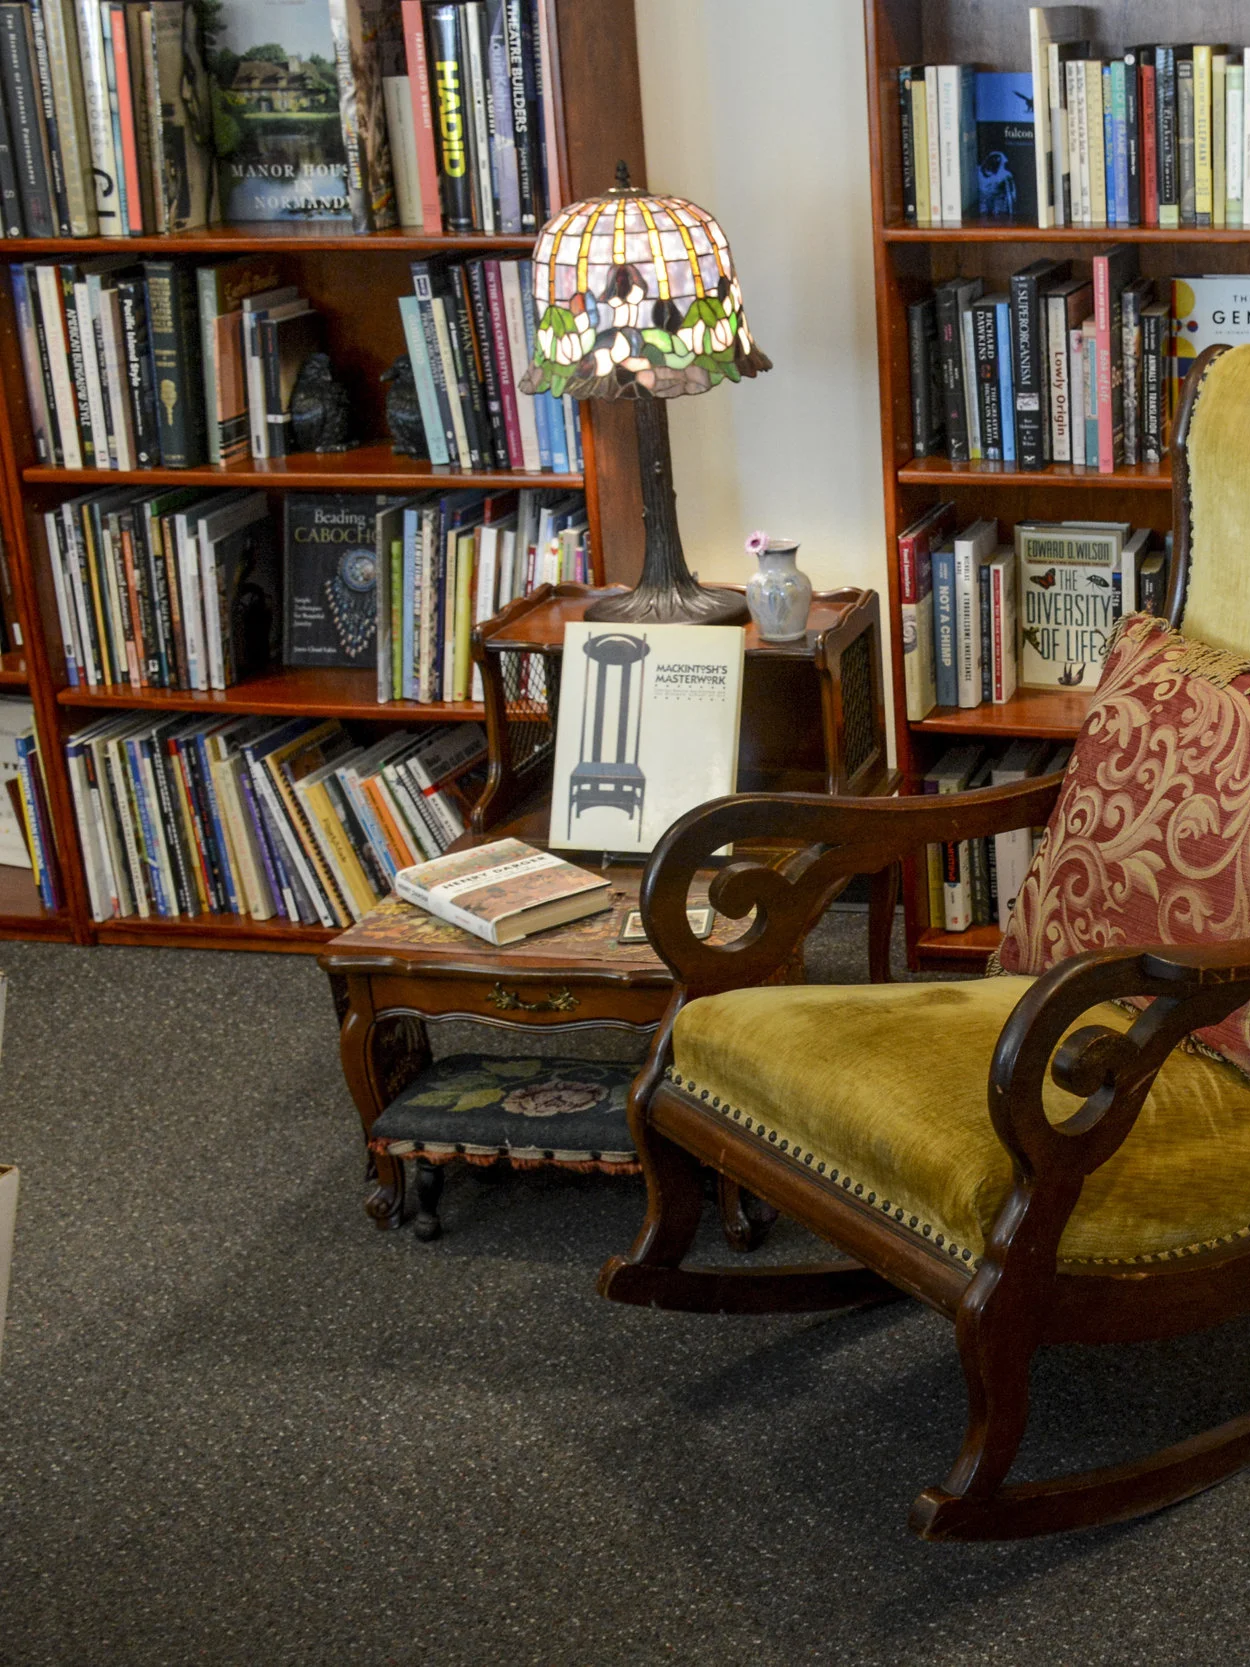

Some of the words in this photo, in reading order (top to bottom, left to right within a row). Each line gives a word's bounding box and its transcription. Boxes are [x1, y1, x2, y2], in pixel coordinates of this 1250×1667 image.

[415, 33, 424, 62] FRANK
[507, 4, 521, 63] THEATRE
[417, 65, 426, 92] LLOYD
[420, 95, 430, 129] WRIGHT
[511, 68, 527, 133] BUILDERS
[435, 61, 465, 178] HADID
[1004, 128, 1033, 138] falcon
[1163, 109, 1171, 150] Elephant
[1199, 119, 1207, 167] ELEPHANT
[230, 164, 295, 177] MANOR
[519, 147, 528, 170] JAMES
[521, 172, 530, 199] STEELE
[1164, 154, 1172, 198] Memories
[123, 299, 136, 330] Pacific
[491, 300, 500, 322] ARTS
[126, 332, 138, 362] Island
[495, 330, 505, 360] CRAFTS
[976, 311, 986, 360] DAWKINS
[985, 312, 995, 359] RICHARD
[1018, 289, 1032, 385] SUPERORGANISM
[66, 309, 80, 353] AMERICAN
[79, 401, 90, 427] STYLE
[129, 363, 140, 387] Style
[500, 360, 509, 385] STYLE
[1053, 351, 1065, 389] Lowly
[1099, 350, 1109, 371] Book
[1148, 354, 1156, 382] ANIMALS
[1100, 374, 1109, 384] of
[1100, 385, 1109, 403] Life
[990, 403, 998, 439] GREATEST
[1054, 395, 1067, 436] Origin
[1148, 393, 1156, 434] TRANSLATION
[985, 418, 993, 444] EARTH
[314, 509, 366, 528] Beading
[1027, 540, 1064, 559] EDWARD
[1077, 541, 1109, 561] WILSON
[1058, 568, 1078, 592] THE
[939, 585, 951, 612] NOT
[1026, 591, 1113, 627] DIVERSITY
[940, 614, 951, 623] A
[940, 625, 952, 667] CHIMP
[1041, 628, 1060, 661] OF
[1067, 630, 1098, 663] LIFE
[442, 872, 487, 889] HENRY
[493, 856, 546, 873] DARGER
